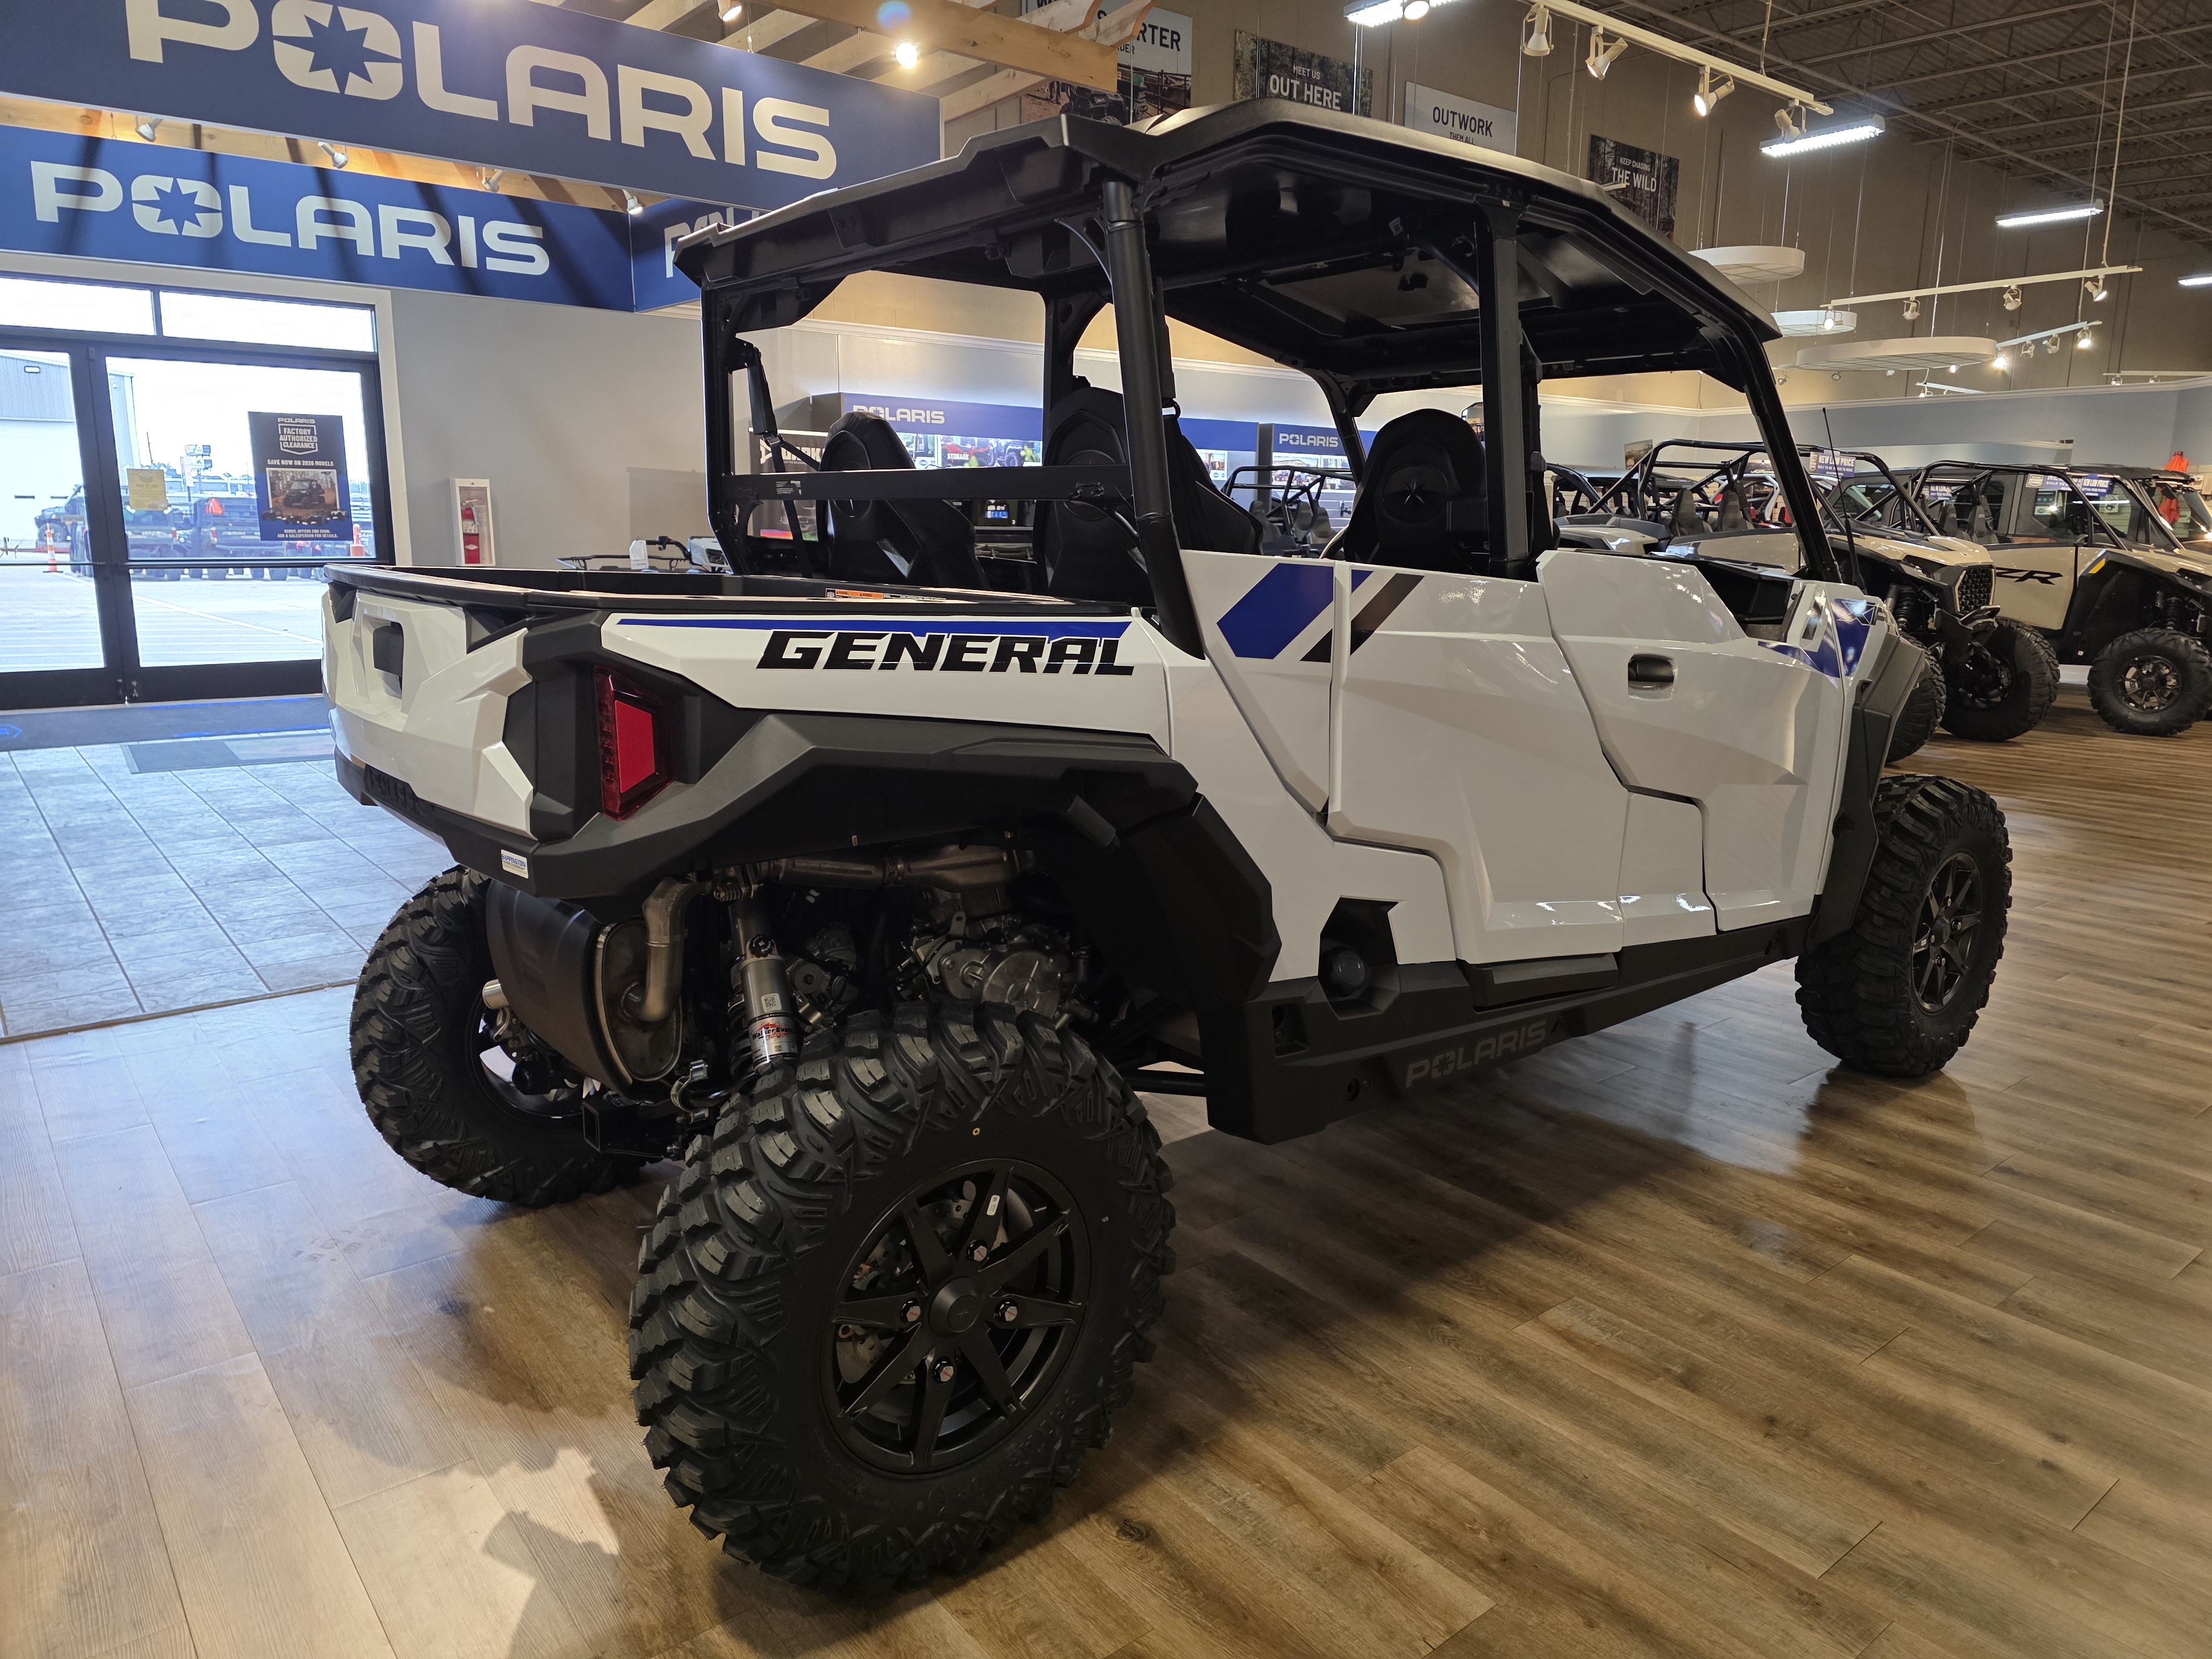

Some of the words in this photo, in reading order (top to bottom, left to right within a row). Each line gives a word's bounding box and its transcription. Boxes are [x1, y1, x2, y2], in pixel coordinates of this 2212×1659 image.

[1293, 64, 1311, 77] MEET
[1312, 70, 1321, 80] US
[125, 0, 837, 180] POLARIS
[1270, 74, 1300, 101] OUT
[1304, 83, 1342, 111] HERE
[1433, 106, 1493, 138] OUTWORK
[1449, 132, 1464, 142] THEM
[1620, 156, 1632, 165] KEEP
[1632, 160, 1651, 171] CHASING
[1612, 166, 1631, 186] THE
[1633, 172, 1657, 192] WILD
[30, 161, 550, 275] POLARIS
[1279, 433, 1338, 447] POLARIS
[1818, 455, 1829, 463] NEW
[1840, 457, 1855, 466] PRICE
[1996, 567, 2063, 585] ZR
[755, 630, 1135, 676] GENERAL
[1406, 1020, 1547, 1088] POLARIS
